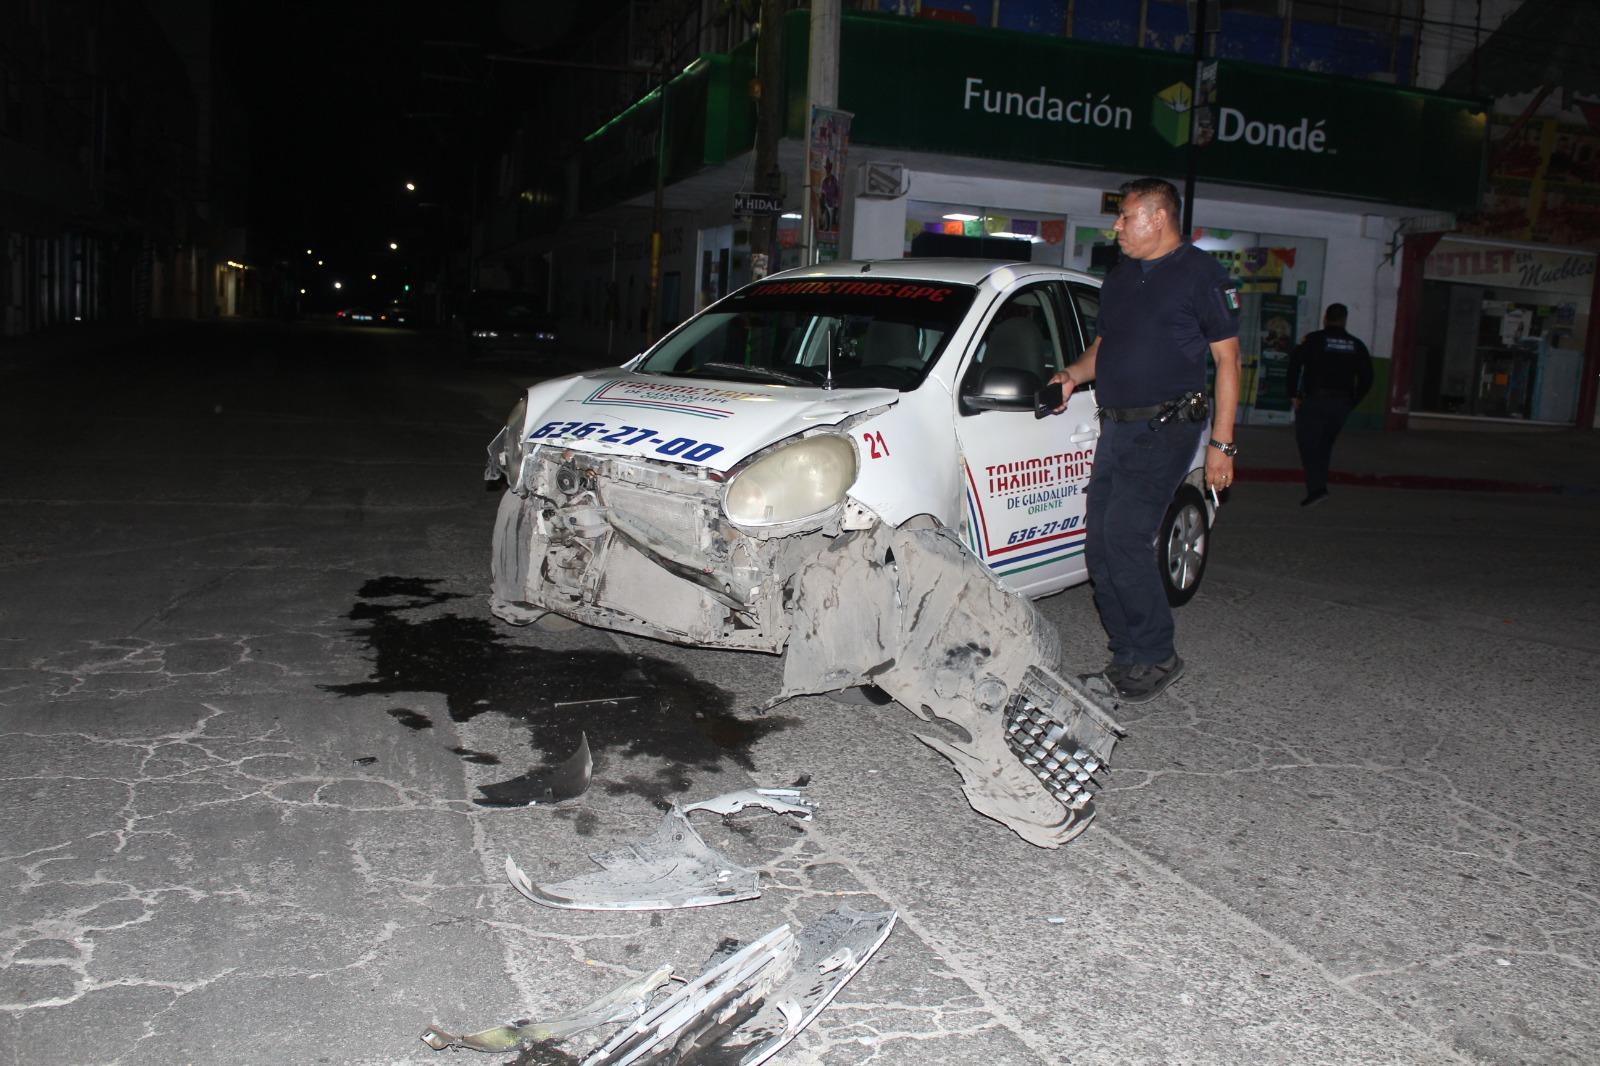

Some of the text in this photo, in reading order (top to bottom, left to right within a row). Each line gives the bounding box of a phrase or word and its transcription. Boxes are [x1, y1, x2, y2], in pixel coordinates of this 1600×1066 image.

[963, 76, 1326, 154] Fundación Dondé
[1520, 254, 1595, 287] Muebles
[530, 421, 726, 462] 636-27-00
[863, 430, 892, 459] 21
[985, 449, 1093, 498] TAXIMETROS
[1007, 484, 1078, 509] DE GUADALUPE
[1028, 500, 1063, 515] ORIENTE
[1007, 515, 1080, 545] 636-27-00
